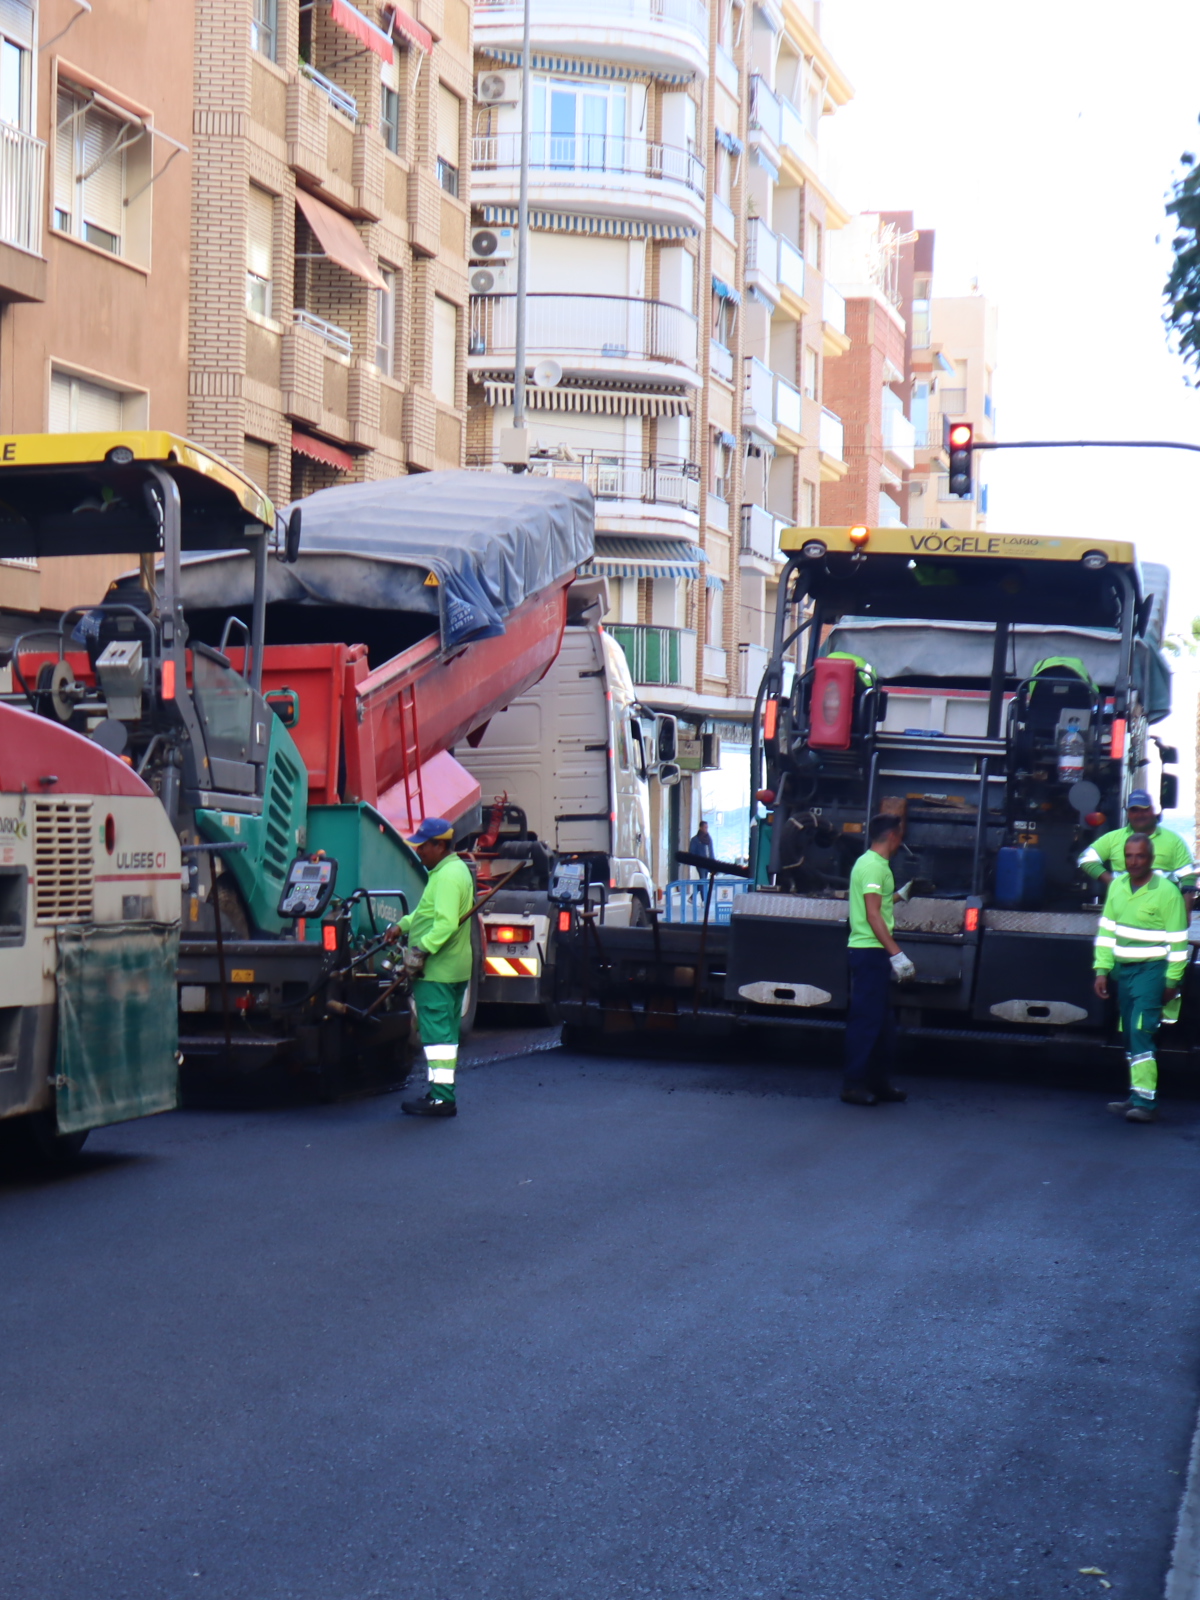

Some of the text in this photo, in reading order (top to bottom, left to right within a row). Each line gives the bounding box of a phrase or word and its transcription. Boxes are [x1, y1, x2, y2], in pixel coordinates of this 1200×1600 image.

[910, 532, 1001, 553] VÖGELE
[1002, 537, 1039, 546] LARIO
[116, 852, 155, 869] ULISES
